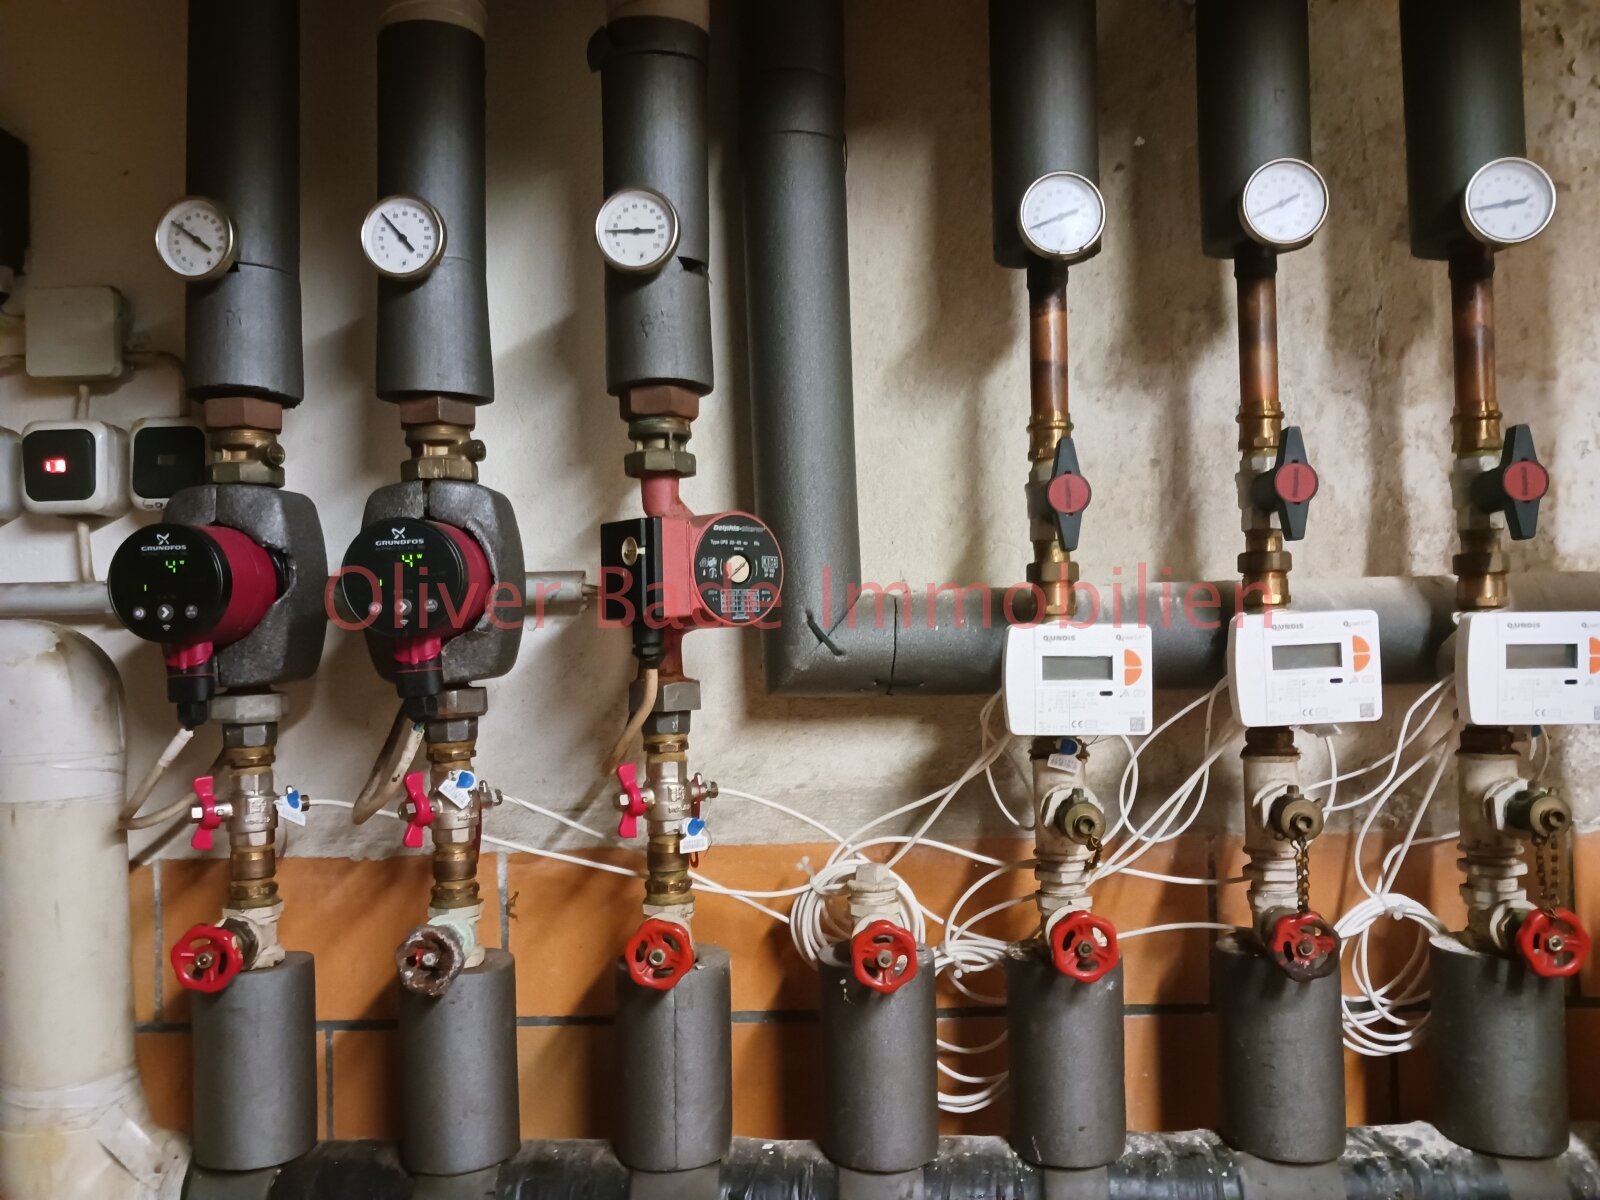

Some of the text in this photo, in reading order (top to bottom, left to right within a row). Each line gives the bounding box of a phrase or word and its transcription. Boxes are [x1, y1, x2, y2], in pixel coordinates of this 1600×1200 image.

[375, 538, 425, 546] GRUNDFOS
[141, 544, 187, 552] GRUNDFOS
[1043, 635, 1076, 643] QUNDIS
